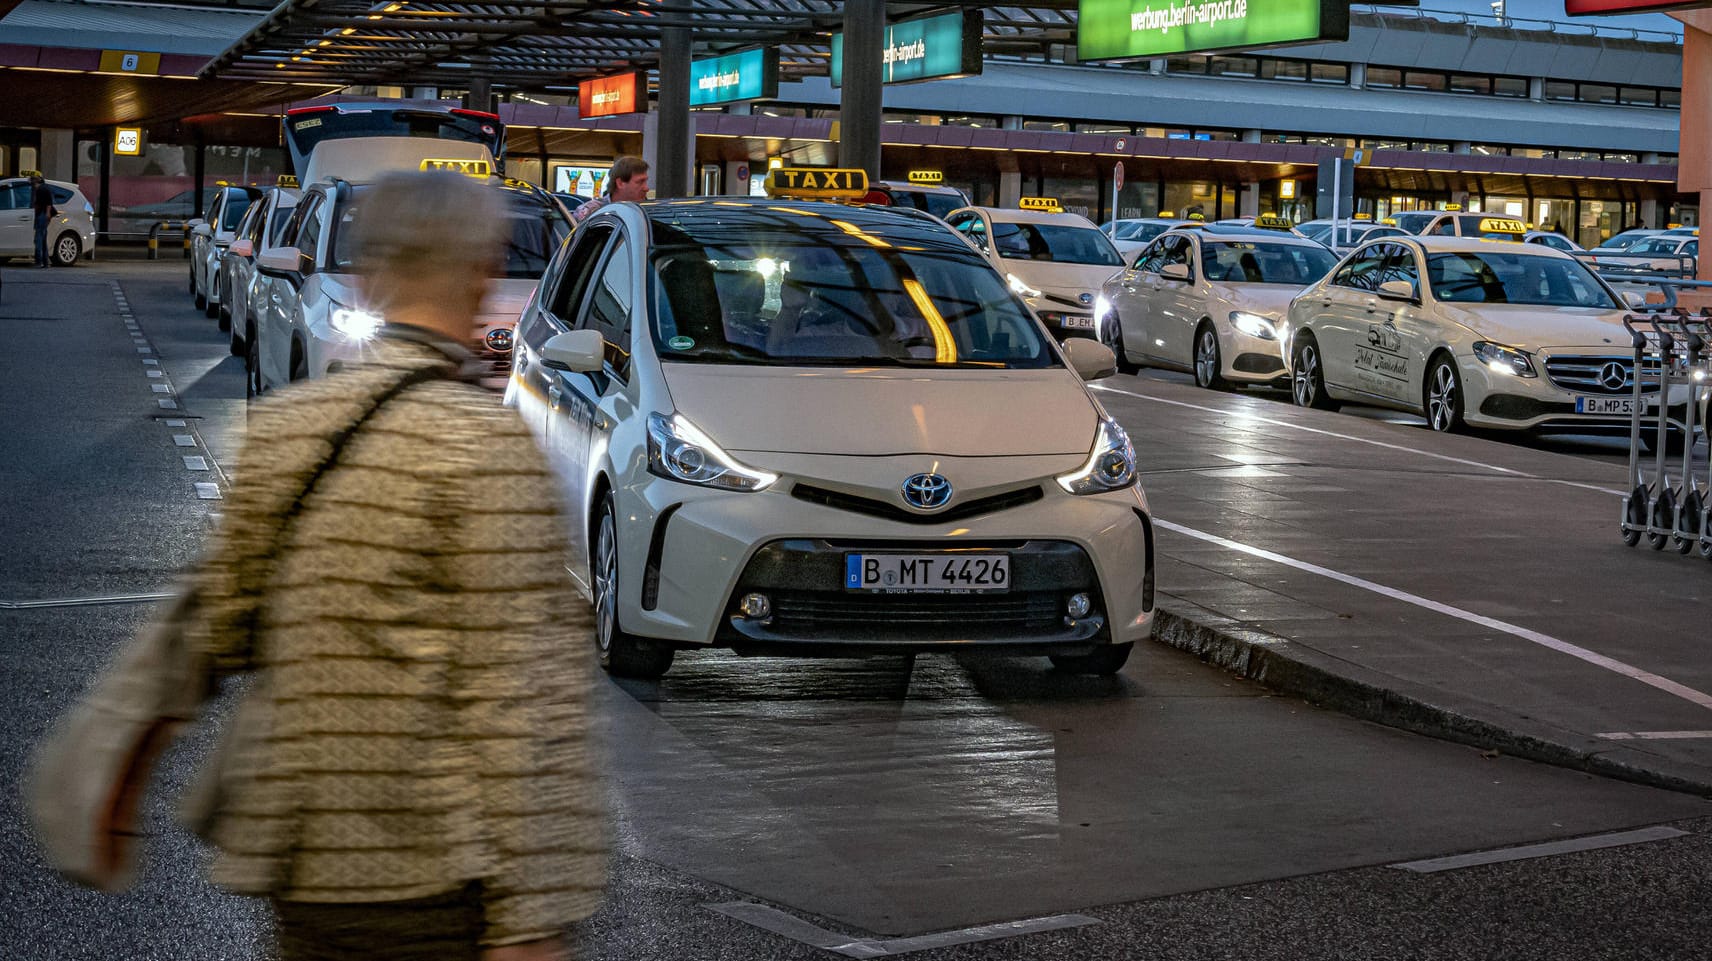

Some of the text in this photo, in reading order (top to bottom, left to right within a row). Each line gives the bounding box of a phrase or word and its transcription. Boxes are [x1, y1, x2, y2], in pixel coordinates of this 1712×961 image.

[1131, 0, 1247, 34] werbung.berlin-airport.de
[883, 39, 925, 64] erlin-airport.de
[126, 58, 133, 67] 6
[784, 172, 853, 188] TAXI
[1263, 217, 1288, 226] TAXI
[1490, 221, 1522, 232] TAXI
[1588, 400, 1597, 411] B
[1604, 400, 1620, 412] MP
[864, 559, 1006, 585] B MT 4426
